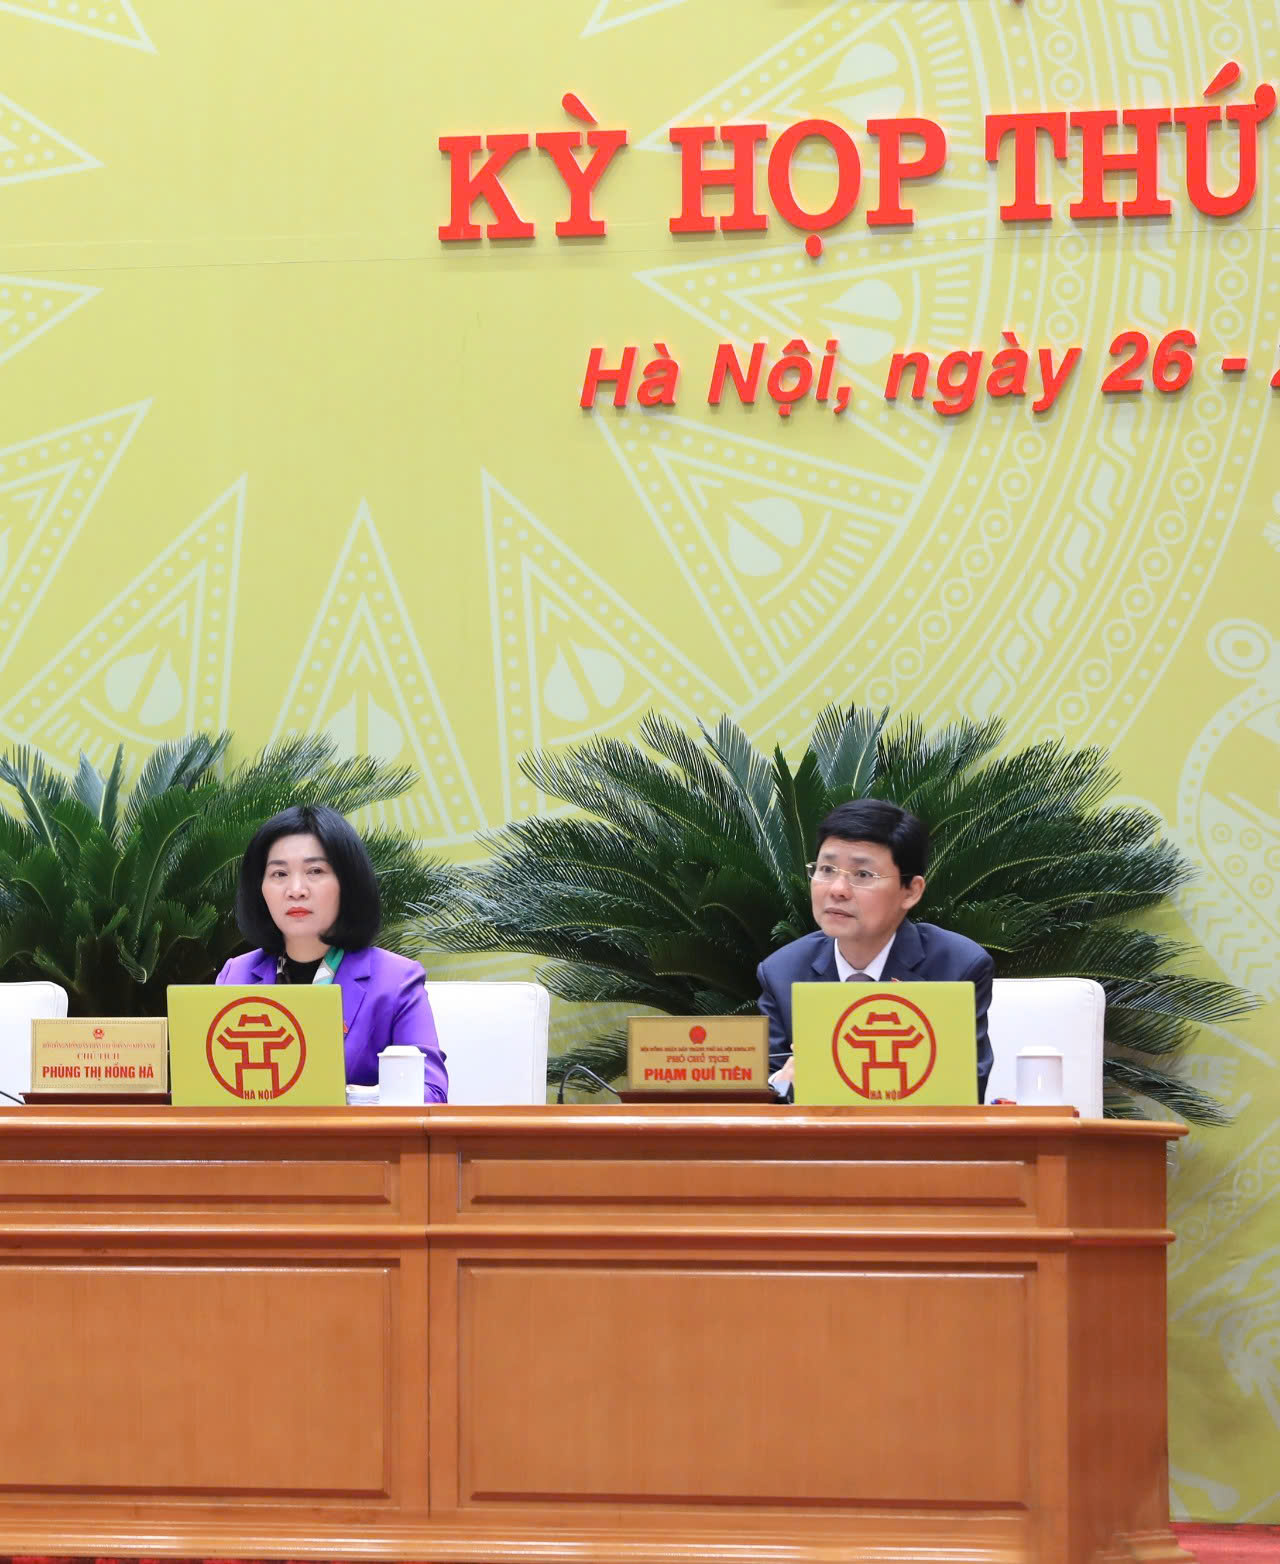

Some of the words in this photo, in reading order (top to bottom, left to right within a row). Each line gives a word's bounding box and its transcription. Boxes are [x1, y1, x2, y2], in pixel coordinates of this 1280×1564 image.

[438, 92, 628, 242] KỲ
[669, 117, 947, 258] HỌP
[984, 61, 1278, 222] THỨ
[580, 342, 680, 408] Hà
[707, 339, 852, 418] Nội,
[884, 331, 1082, 416] ngày
[1101, 329, 1198, 394] 26
[84, 1065, 102, 1081] THỊ
[644, 1067, 687, 1083] PHẠM
[691, 1065, 716, 1082] QUÍ
[719, 1065, 753, 1081] TIÊN
